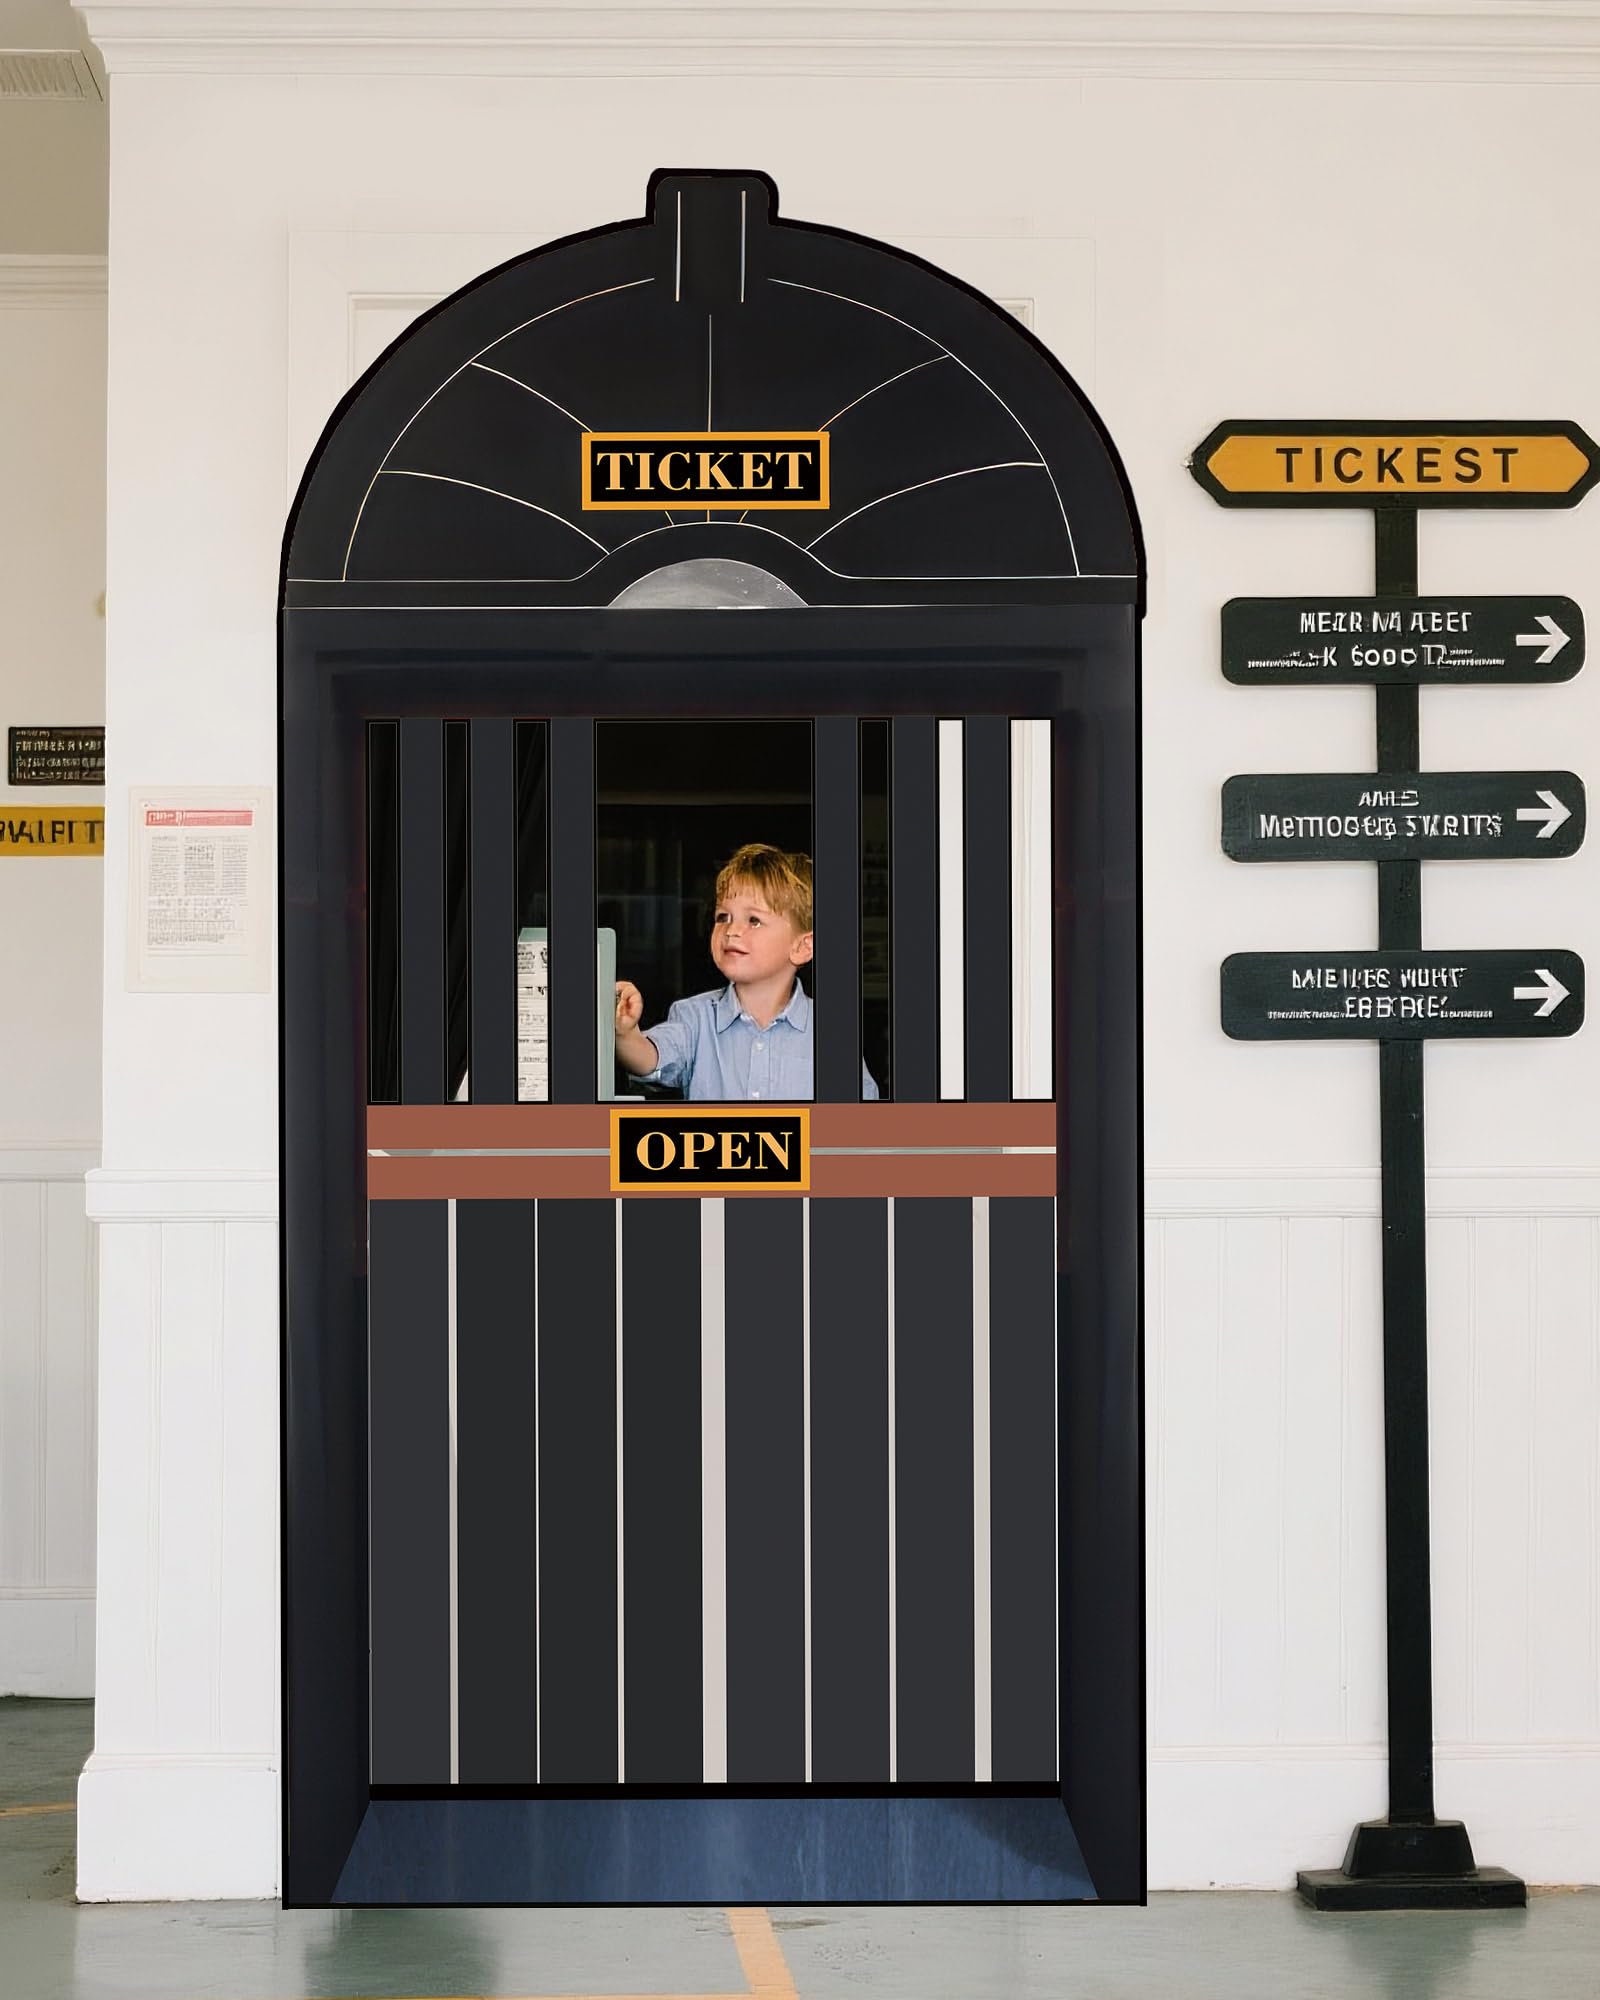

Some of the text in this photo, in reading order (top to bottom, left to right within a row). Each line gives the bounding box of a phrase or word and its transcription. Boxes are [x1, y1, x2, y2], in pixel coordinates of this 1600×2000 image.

[596, 451, 812, 491] TICKET
[1275, 447, 1519, 484] TICKEST
[636, 1131, 793, 1171] OPEN
